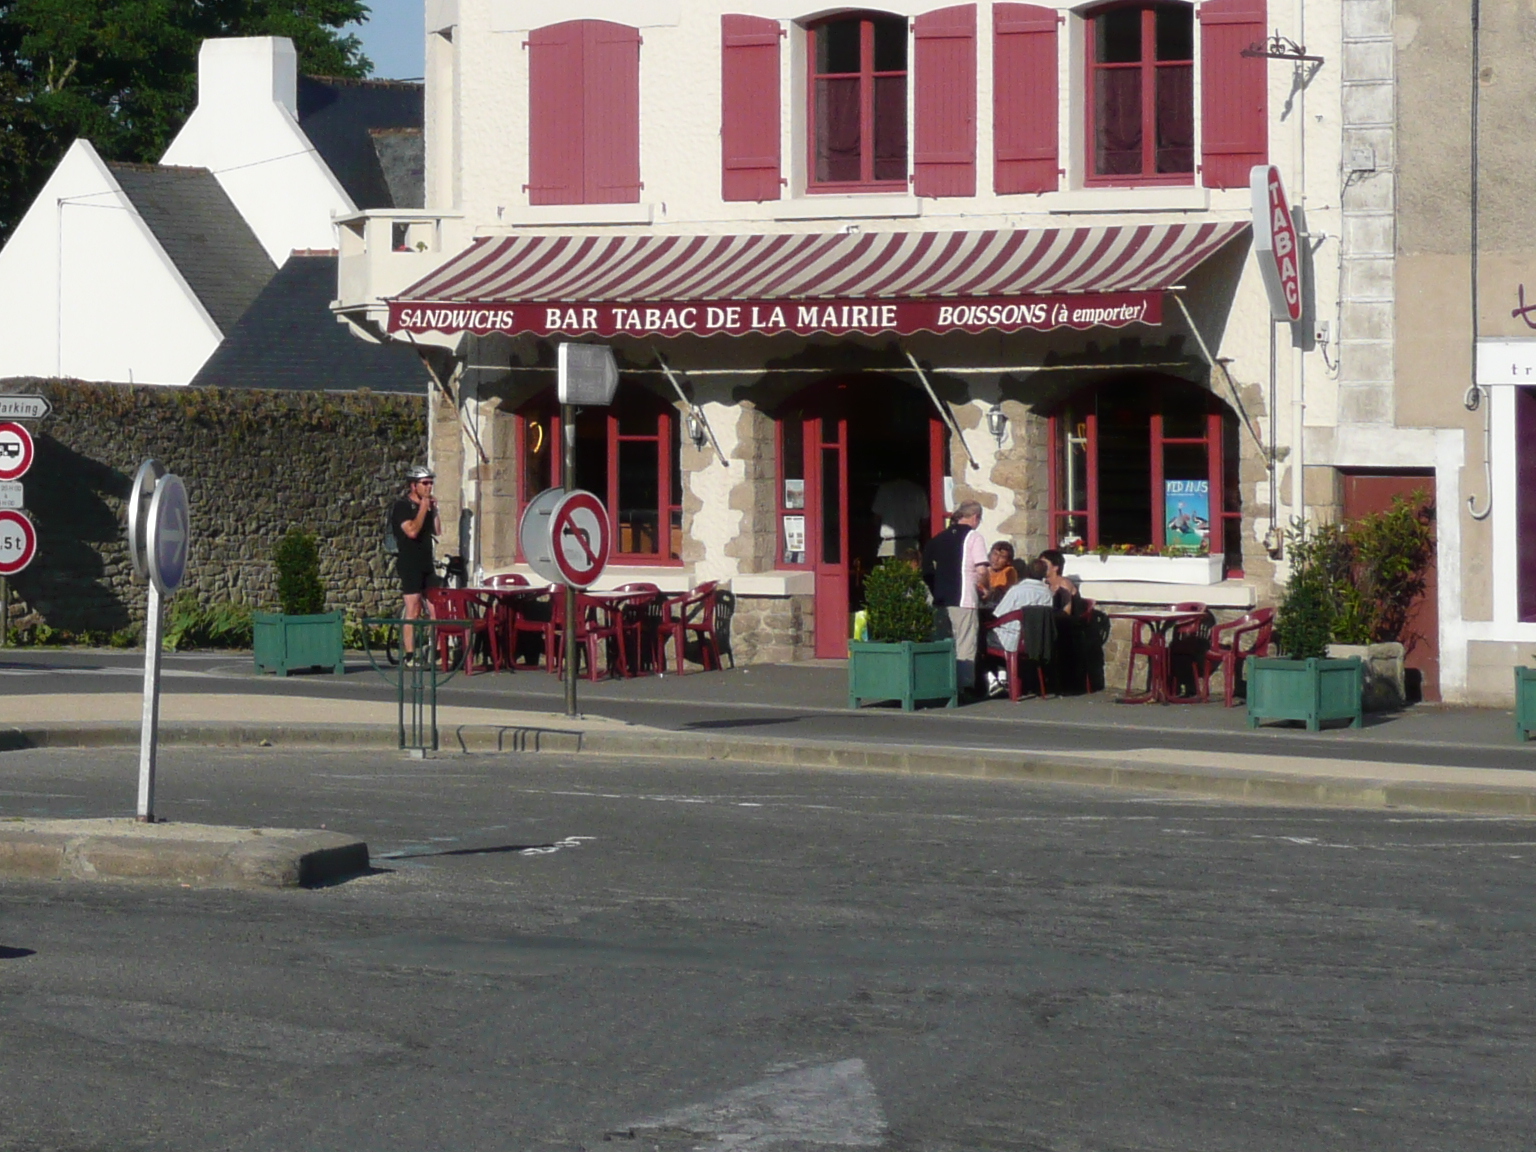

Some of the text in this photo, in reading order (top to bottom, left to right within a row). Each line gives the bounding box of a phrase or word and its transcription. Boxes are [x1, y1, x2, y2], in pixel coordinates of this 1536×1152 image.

[1269, 181, 1298, 305] TABAC
[399, 300, 1148, 330] SANDWICHS BAR TABAC DE LA MAIRIE BOISSONS (à emporter)
[15, 537, 22, 550] t
